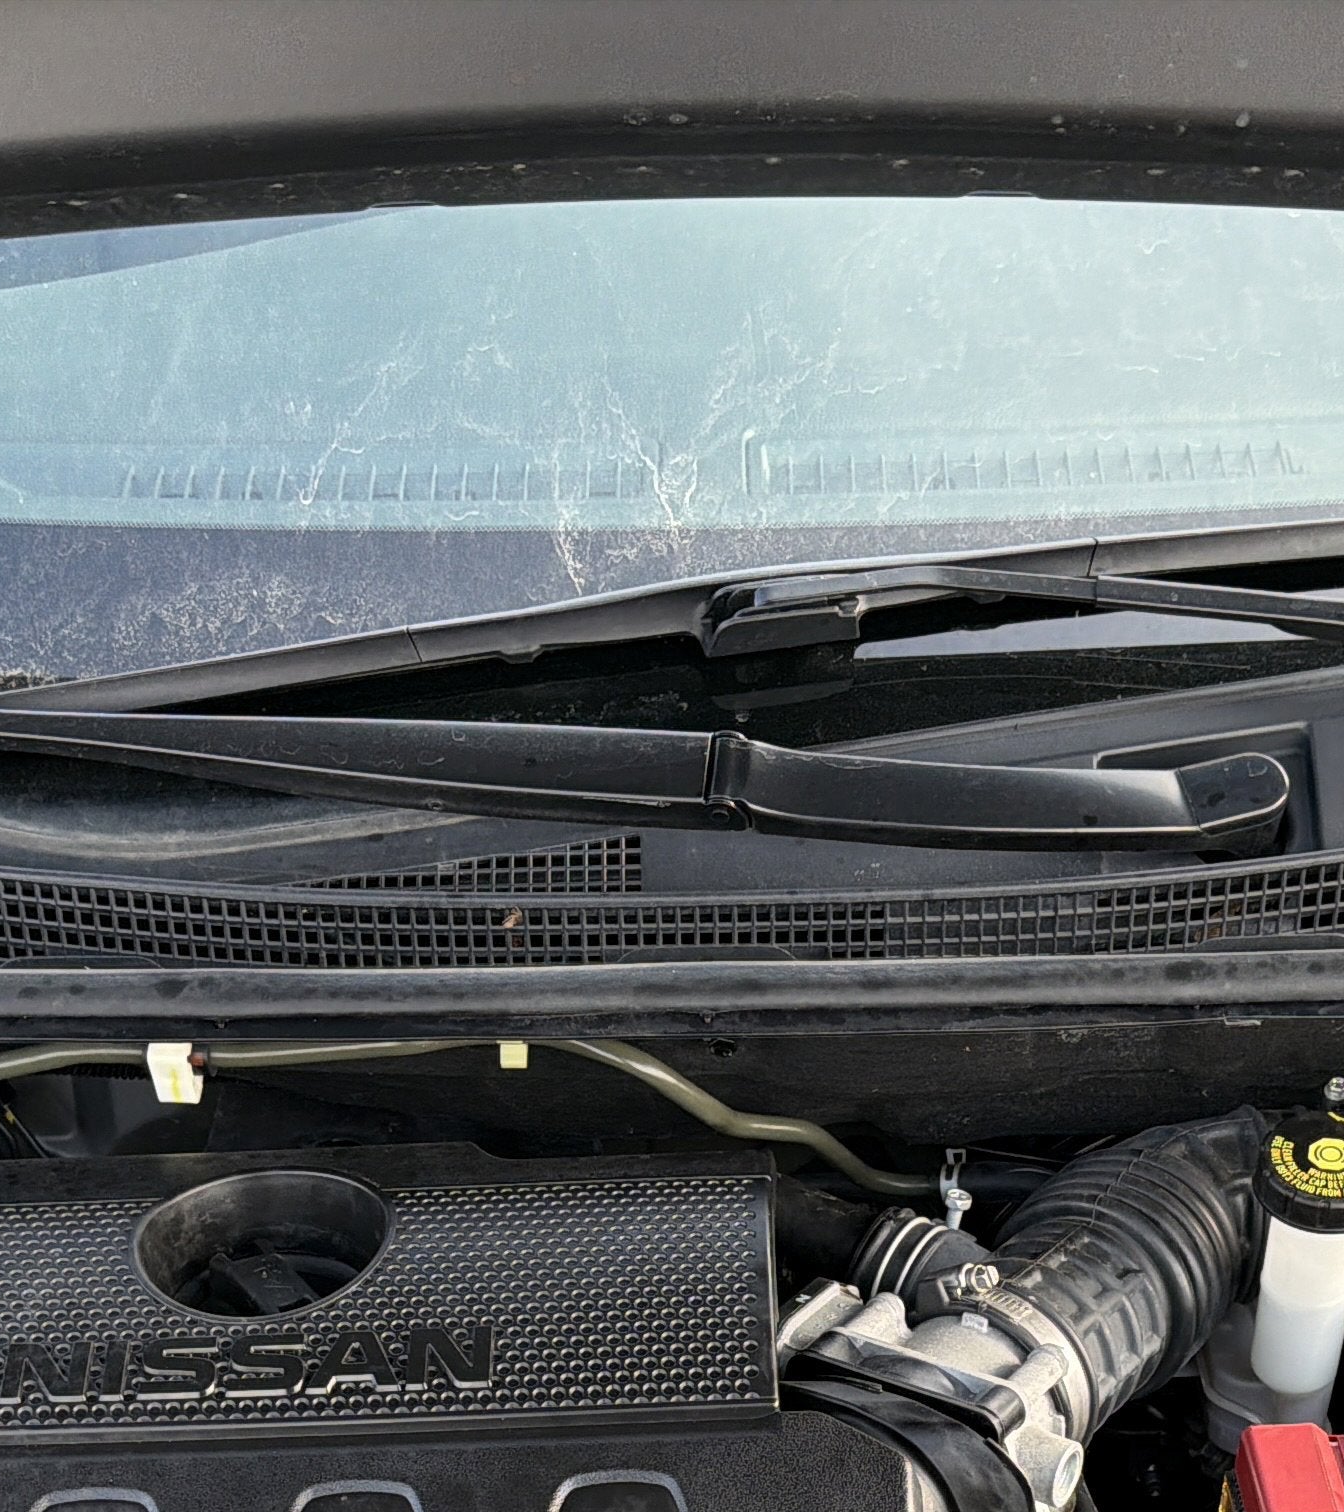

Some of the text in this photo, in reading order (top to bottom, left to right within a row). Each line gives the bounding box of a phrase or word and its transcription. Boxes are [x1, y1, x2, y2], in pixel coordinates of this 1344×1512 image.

[1290, 1178, 1316, 1194] FLUID
[1316, 1187, 1343, 1198] FROM
[1308, 1177, 1327, 1188] CAP
